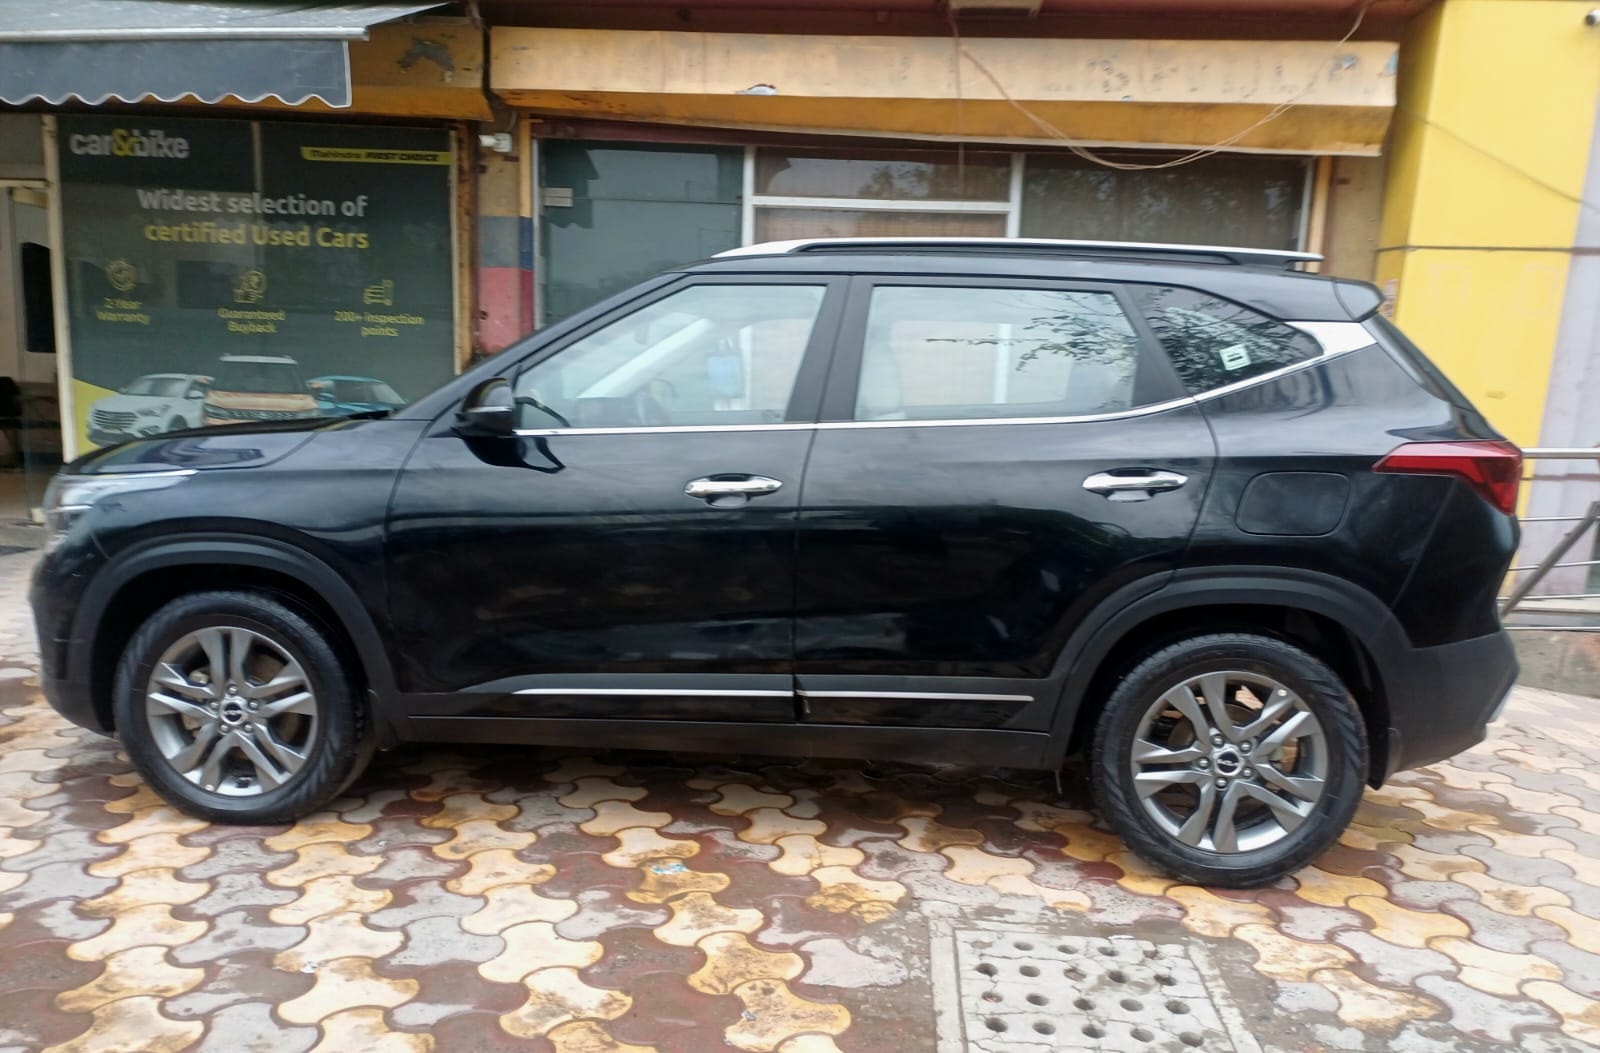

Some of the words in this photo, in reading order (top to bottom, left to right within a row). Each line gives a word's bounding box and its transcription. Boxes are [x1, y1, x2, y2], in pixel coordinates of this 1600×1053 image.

[69, 128, 190, 158] car&bike
[136, 188, 222, 213] Widest
[227, 191, 336, 217] selection
[340, 195, 369, 217] of
[144, 221, 246, 246] certified
[251, 223, 311, 247] Used
[315, 226, 369, 249] Cars
